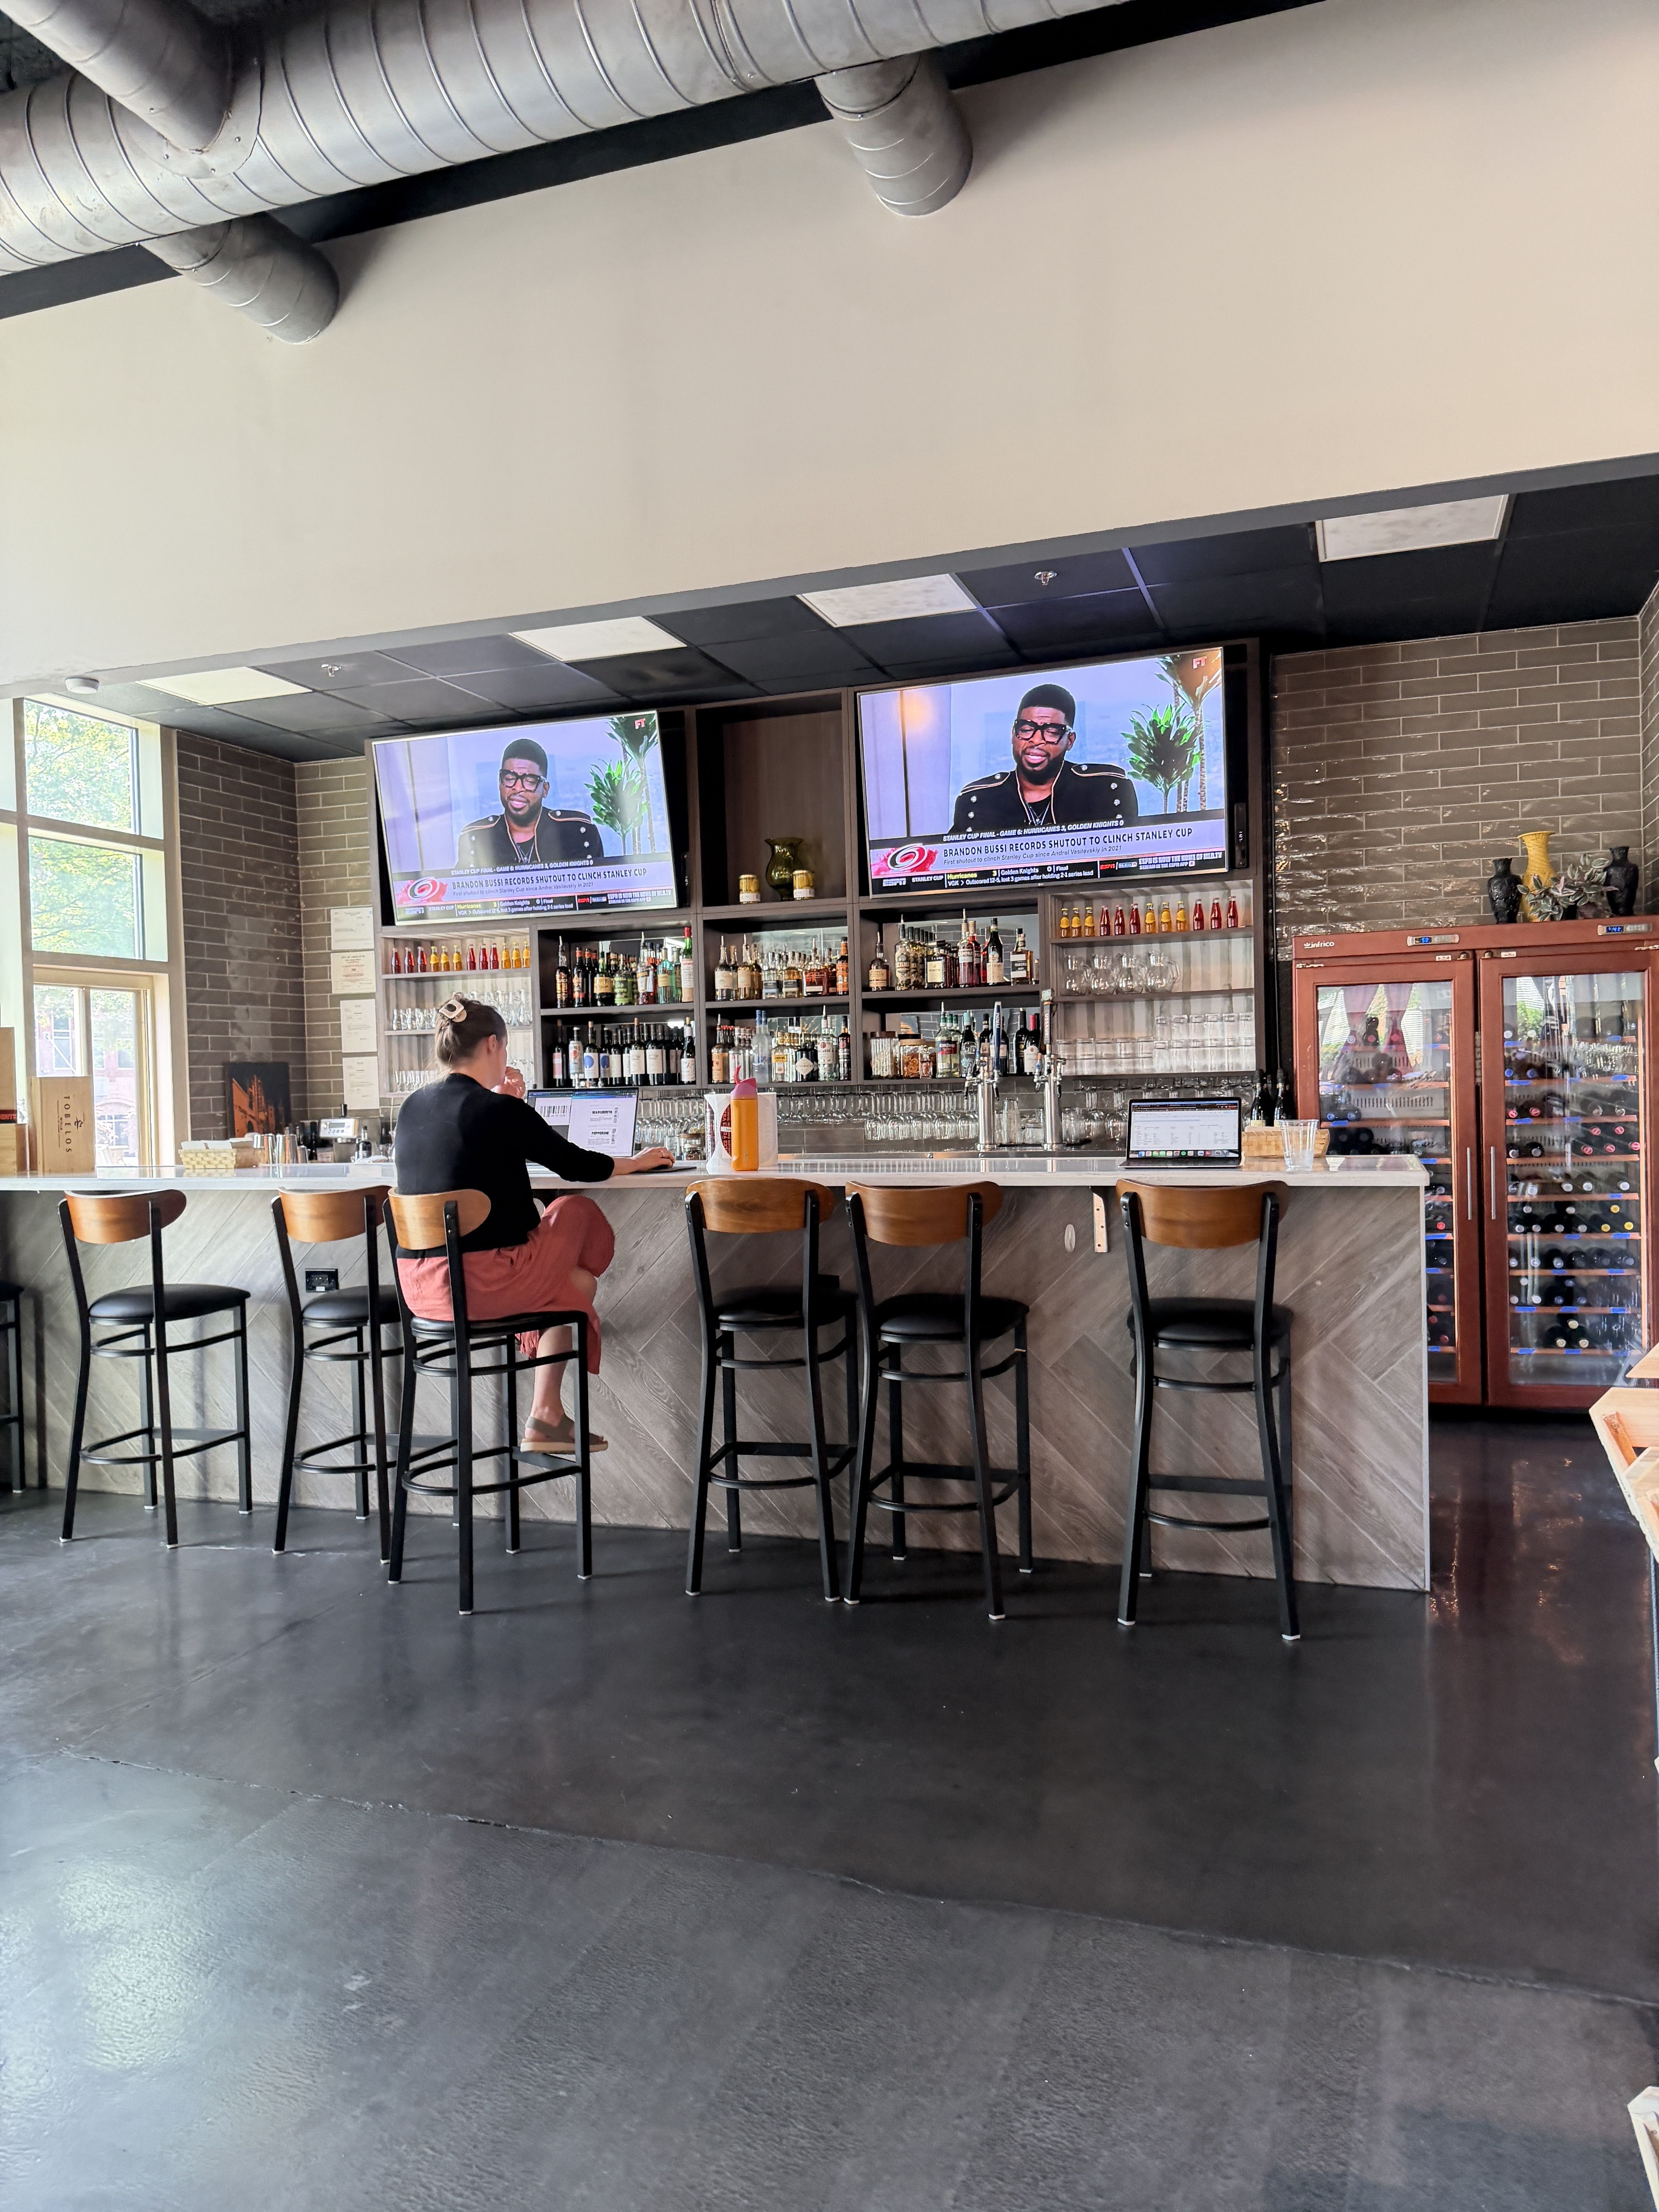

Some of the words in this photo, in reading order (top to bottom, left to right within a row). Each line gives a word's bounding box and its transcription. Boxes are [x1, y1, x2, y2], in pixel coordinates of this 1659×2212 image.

[1193, 656, 1207, 669] FT
[635, 718, 646, 729] FT
[1092, 820, 1119, 829] KNIGHTS
[944, 846, 982, 857] BRANDON
[985, 844, 1007, 854] BUSSI
[1010, 841, 1046, 852] RECORDS
[1049, 837, 1087, 848] SHUTOUT
[1089, 836, 1100, 845] TO
[1103, 833, 1133, 843] CLINCH
[1136, 830, 1173, 841] STANLEY
[1176, 828, 1192, 837] CUP
[452, 879, 484, 890] BRANDON
[485, 878, 503, 887] BUSSI
[505, 877, 534, 886] RECORDS
[536, 874, 565, 883] SHUTOUT
[567, 873, 576, 882] TO
[578, 871, 601, 880] CLINCH
[603, 869, 632, 879] STANLEY
[634, 868, 647, 876] CUP
[883, 878, 906, 887] ESPN
[64, 1096, 72, 1152] TOBELOS
